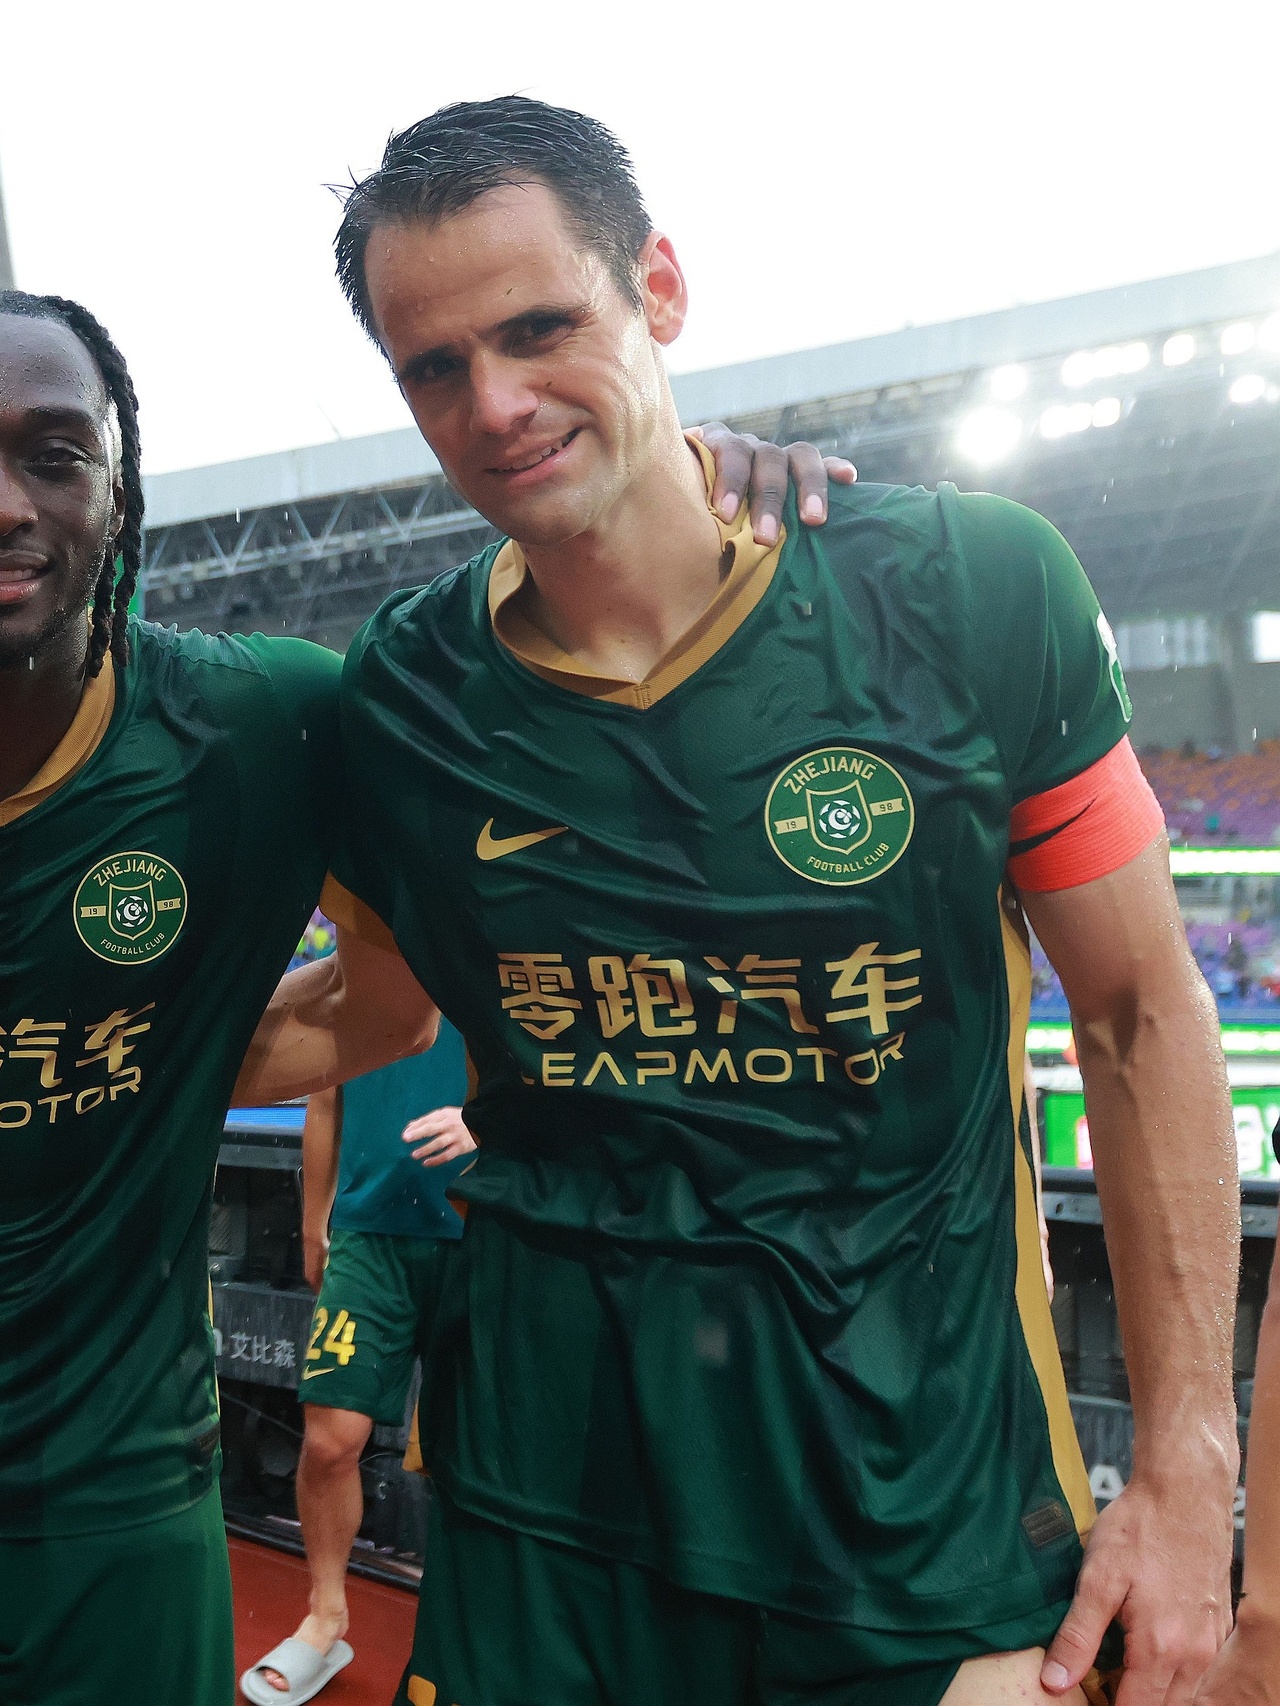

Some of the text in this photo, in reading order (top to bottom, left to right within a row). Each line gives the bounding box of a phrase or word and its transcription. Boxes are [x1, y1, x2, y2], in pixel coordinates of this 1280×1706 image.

[783, 756, 877, 795] ZHEJIANG
[879, 802, 893, 812] 98
[785, 820, 797, 831] 19
[93, 859, 167, 887] ZHEJIANG
[806, 842, 890, 874] FOOTBALL CLUB
[88, 907, 98, 916] 19
[163, 900, 174, 909] 98
[100, 932, 165, 955] FOOTBALL CLUB
[497, 941, 923, 1041] 零跑汽车
[522, 1031, 906, 1087] EAPMOTOR
[229, 1331, 297, 1369] 艾比森
[305, 1307, 357, 1367] 24
